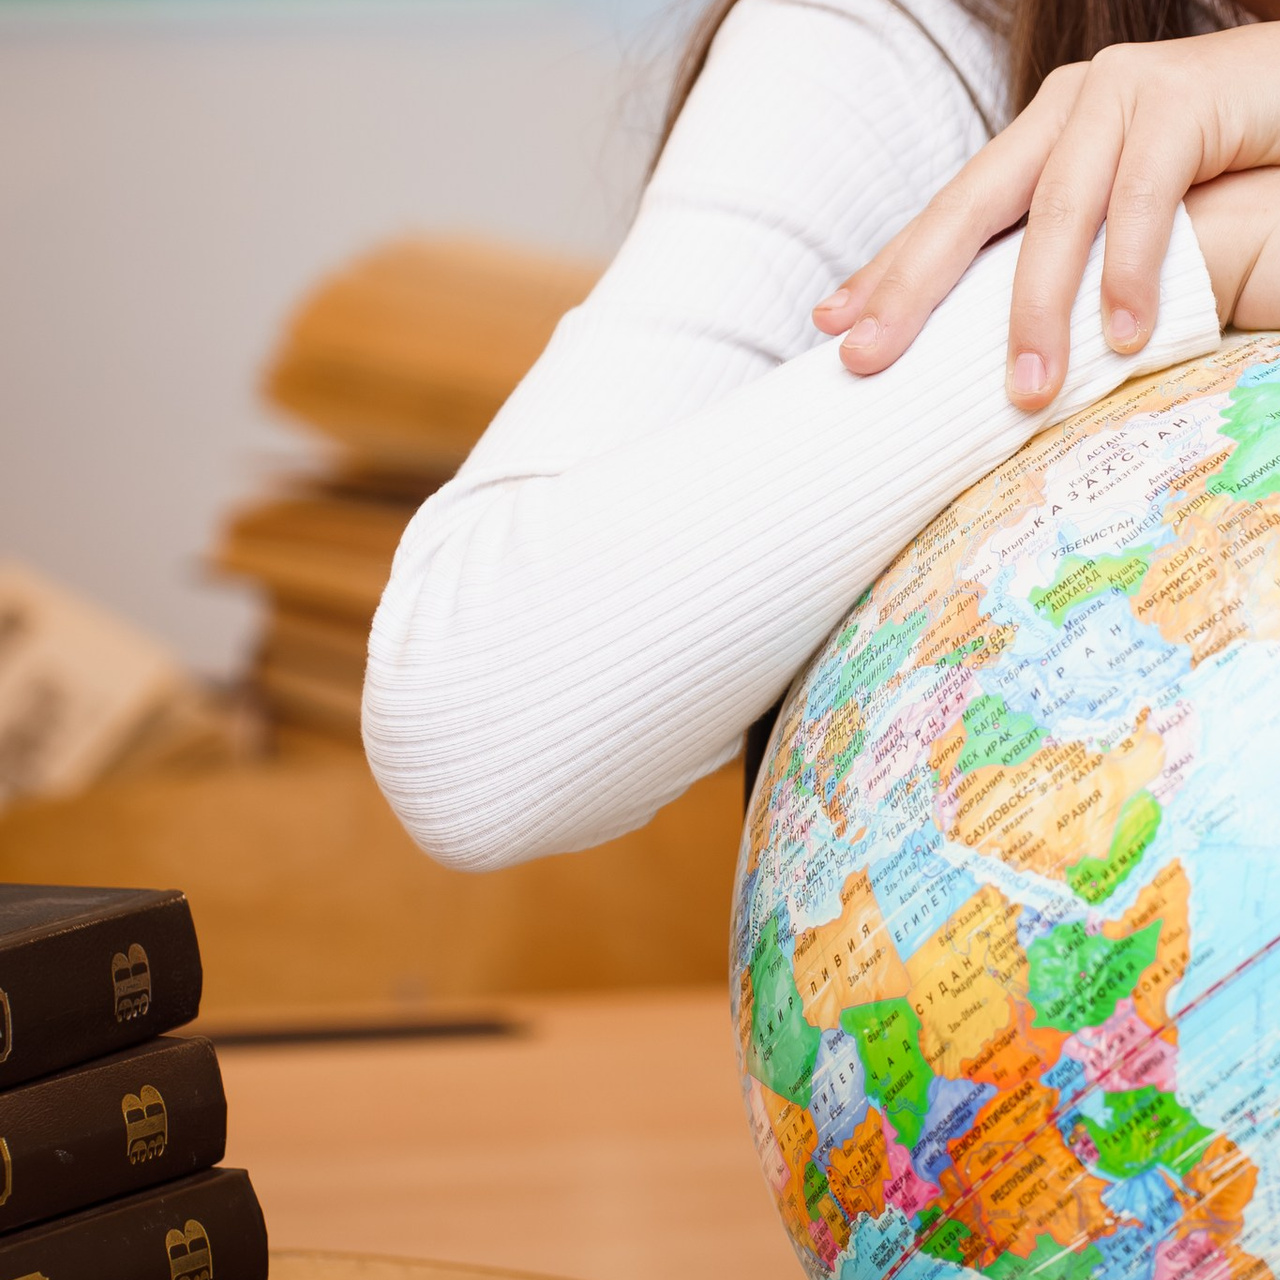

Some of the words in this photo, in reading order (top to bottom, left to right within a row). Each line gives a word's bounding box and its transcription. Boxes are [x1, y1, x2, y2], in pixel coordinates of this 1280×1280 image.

[1084, 428, 1129, 462] АСТАНА
[1032, 415, 1189, 529] КАЗАХСТАН
[1068, 445, 1127, 490] Караганда
[1085, 458, 1147, 504] Жезказган
[1143, 464, 1190, 503] БИШКЕК
[1146, 447, 1200, 486] Алма-Ата
[1171, 448, 1231, 493] КИРГИЗИЯ
[997, 480, 1023, 501] Уфа
[1174, 479, 1227, 521] ДУШАНБЕ
[980, 495, 1022, 531] Самара
[1112, 508, 1165, 551] ТАШКЕНТ
[1216, 498, 1265, 536] Пешавар
[998, 526, 1038, 559] Атырау
[1049, 514, 1136, 560] УЗБЕКИСТАН
[1233, 542, 1266, 571] Лахор
[1106, 556, 1143, 587] Кушка
[1160, 544, 1198, 577] КАБУЛ
[1032, 557, 1097, 612] ТУРКМЕНИЯ
[1047, 568, 1103, 613] АШХАБАД
[1133, 553, 1215, 616] АФГАНИСТАН
[1167, 566, 1219, 607] Кандагар
[905, 589, 982, 658] Ростов-на-Дону
[950, 601, 1004, 650] Махачкала
[987, 616, 1016, 644] БАКУ
[1062, 596, 1105, 632] Мешхед
[1181, 596, 1245, 643] ПАКИСТАН
[969, 634, 986, 651] 29
[975, 647, 992, 664] 33
[1028, 621, 1123, 701] ИРАН
[1043, 622, 1089, 662] ТЕГЕРАН
[1105, 636, 1146, 671] Керман
[920, 660, 965, 702] ТБИЛИСИ
[931, 657, 948, 674] 30
[934, 667, 973, 704] ЕРЕВАН
[960, 694, 993, 723] Мосул
[971, 700, 1011, 737] БАГДАД
[867, 717, 904, 753] Стамбул
[871, 730, 906, 765] АНКАРА
[918, 720, 947, 748] Адана
[929, 735, 966, 770] СИРИЯ
[982, 728, 1013, 757] ИРАК
[940, 749, 980, 788] ДАМАСК
[1069, 752, 1106, 785] КАТАР
[954, 770, 1007, 819] ИОРДАНИЯ
[1053, 788, 1104, 833] АРАВИЯ
[892, 883, 952, 943] ЕГИПЕТ
[806, 923, 873, 996] ЛИВИЯ
[913, 956, 974, 1017] СУДАН
